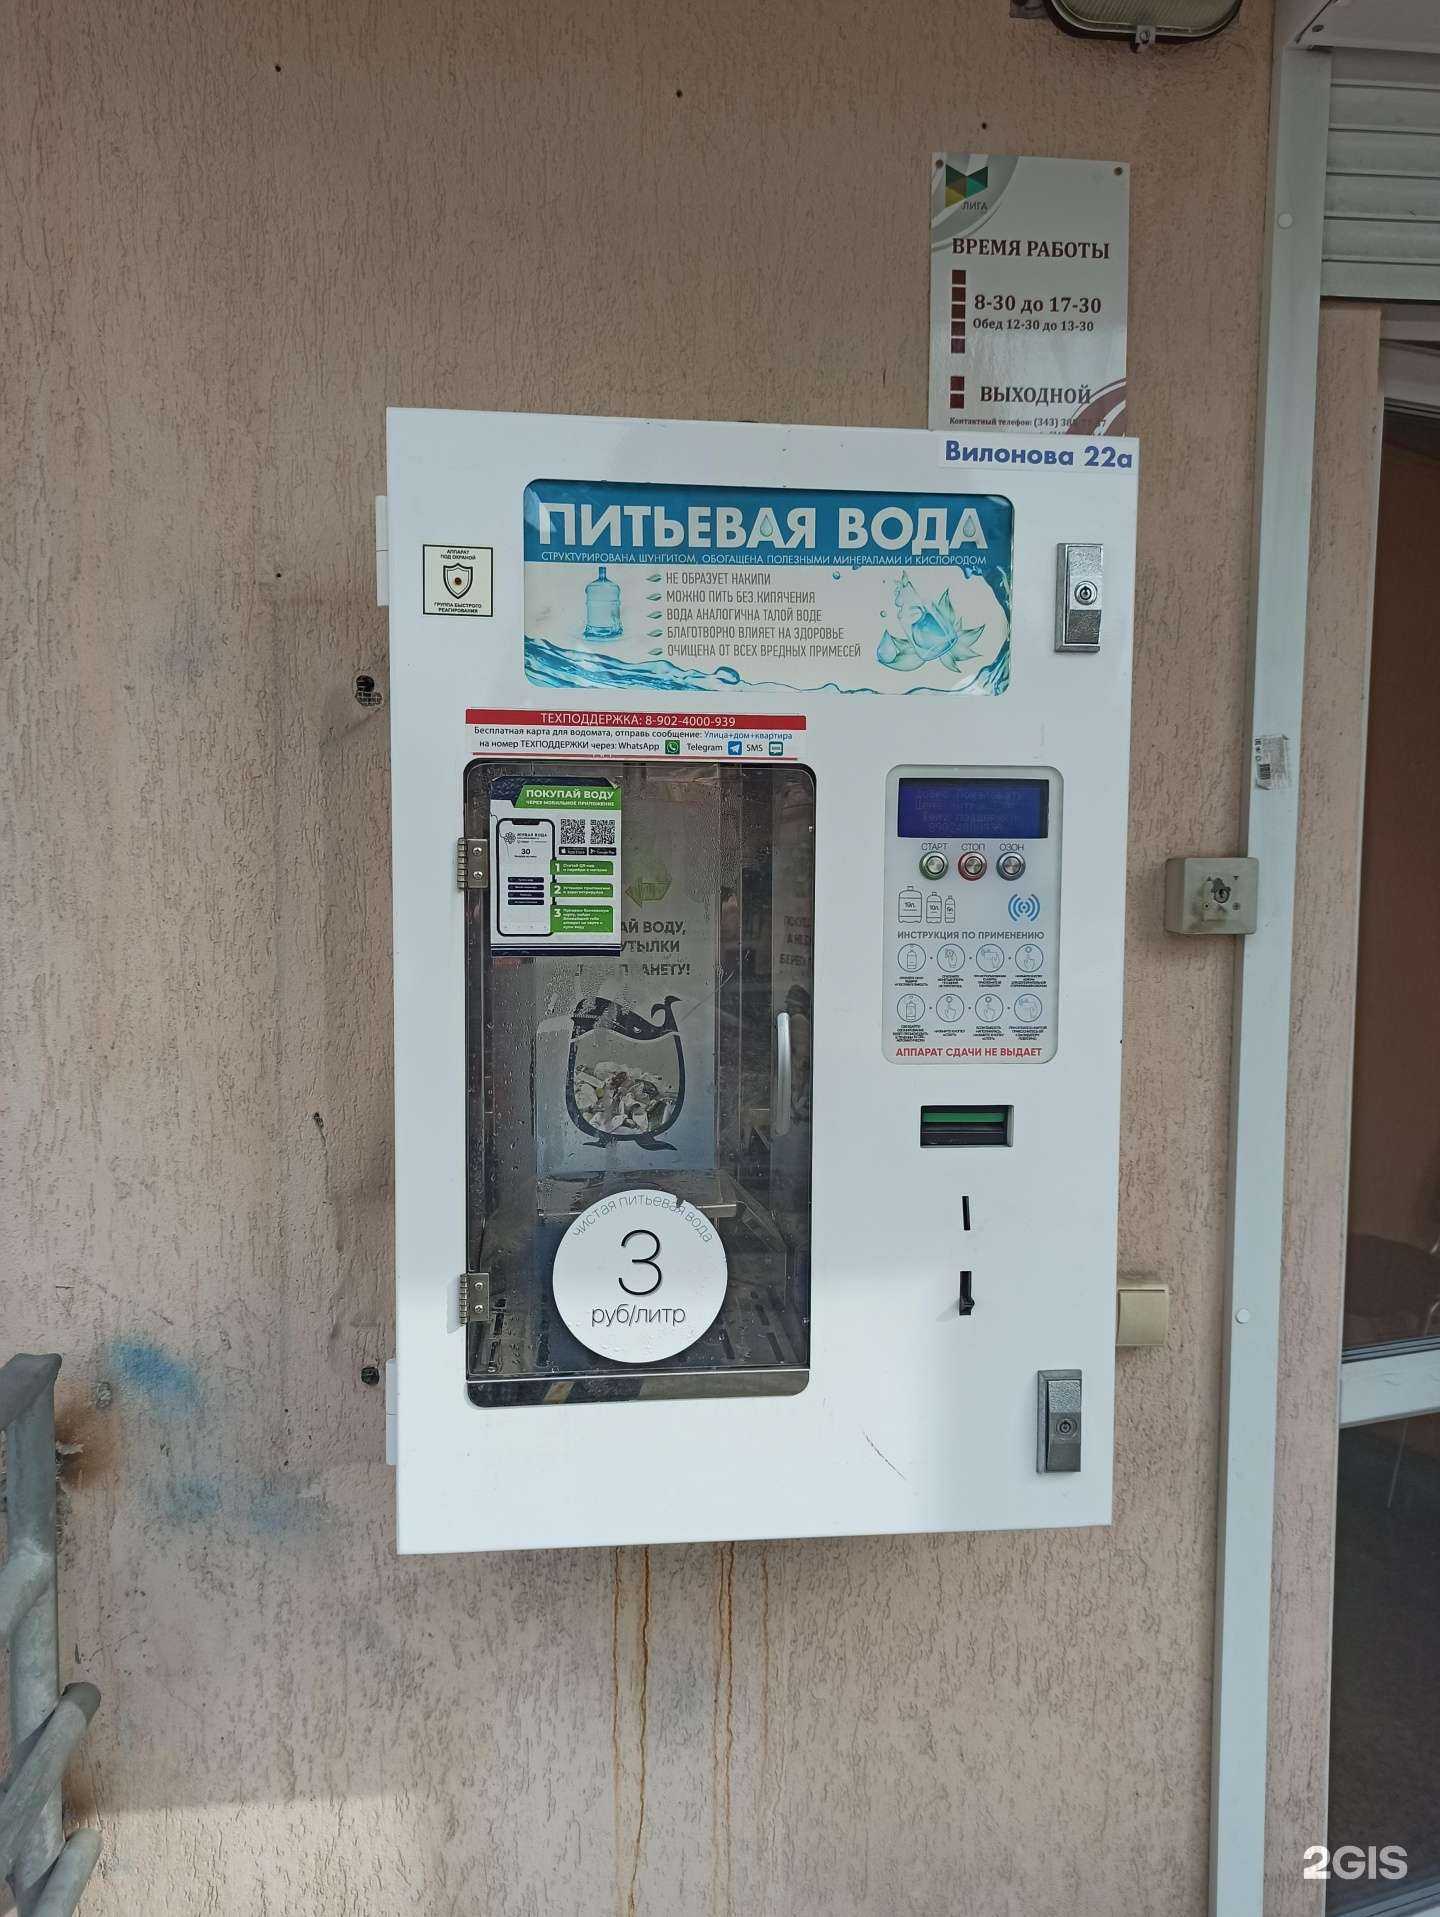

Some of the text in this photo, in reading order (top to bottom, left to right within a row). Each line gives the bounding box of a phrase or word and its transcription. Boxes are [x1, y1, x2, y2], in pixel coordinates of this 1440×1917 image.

[961, 201, 988, 211] ЛИГА
[952, 238, 1110, 259] ВРЕМЯ РАБОТЫ
[974, 295, 1102, 314] 8-30 до 17-30
[973, 319, 1095, 333] Обед 12-30 до 13-30
[980, 384, 1091, 406] ВЫХОДНОЙ
[949, 417, 997, 426] Контактный
[1000, 418, 1032, 427] телефон:
[1034, 418, 1058, 429] (343)
[945, 440, 1132, 468] Вилонова 22а
[539, 503, 988, 555] ПИТЬЕВАЯ ВОДА
[541, 552, 987, 566] СТРУКТУРИРОВАНА ШУНГИТОМ, ОБОГАЩЕНА ПОЛЕЗНЫМИ МИНЕРАЛАМИ И КИСЛОРОДОМ
[666, 572, 771, 585] НЕ ОБРАЗУЕТ НАКИПИ
[666, 590, 816, 603] МОЖНО ПИТЬ БЕЗ КИПЯЧЕНИЯ
[666, 607, 822, 622] ВОДА АНАЛОГИЧНА ТАЛОЙ ВОДЕ
[667, 626, 845, 640] БЛАГОТВОРНО ВЛИЯЕТ НА ЗДОРОВЬЕ
[667, 643, 861, 658] ОЧИЩЕНА ОТ ВСЕХ ВРЕДНЫХ ПРИМЕСЕЙ
[540, 712, 736, 727] ТЕХПОДДЕРЖКА: 8-902-4000-939
[474, 726, 793, 740] Бесплатная карта для водомата, отправь сообщение: Улица+дом+квартира
[491, 741, 518, 750] номер
[521, 740, 589, 750] ТЕХПОДДЕРЖКИ
[591, 743, 617, 751] через:
[618, 742, 660, 752] WhatsApp
[687, 743, 723, 752] Telegram
[746, 744, 763, 752] SMS
[526, 788, 614, 800] ПОКУПАЙ ВОДУ
[921, 843, 948, 851] СТАРТ
[961, 843, 985, 851] СТОП
[999, 843, 1025, 851] ОЗОН
[555, 862, 560, 872] 1
[554, 885, 561, 894] 2
[554, 908, 561, 918] 3
[643, 921, 686, 935] ВОДУ,
[897, 931, 1045, 940] ИНСТРУКЦИЯ ПО ПРИМЕНЕНИЮ
[896, 1048, 1042, 1058] АППАРАТ СДАЧИ НЕ ВЫДАЕТ
[573, 1201, 617, 1236] чистая
[684, 1211, 713, 1243] вода
[618, 1229, 662, 1296] 3
[591, 1303, 686, 1328] руб/литр
